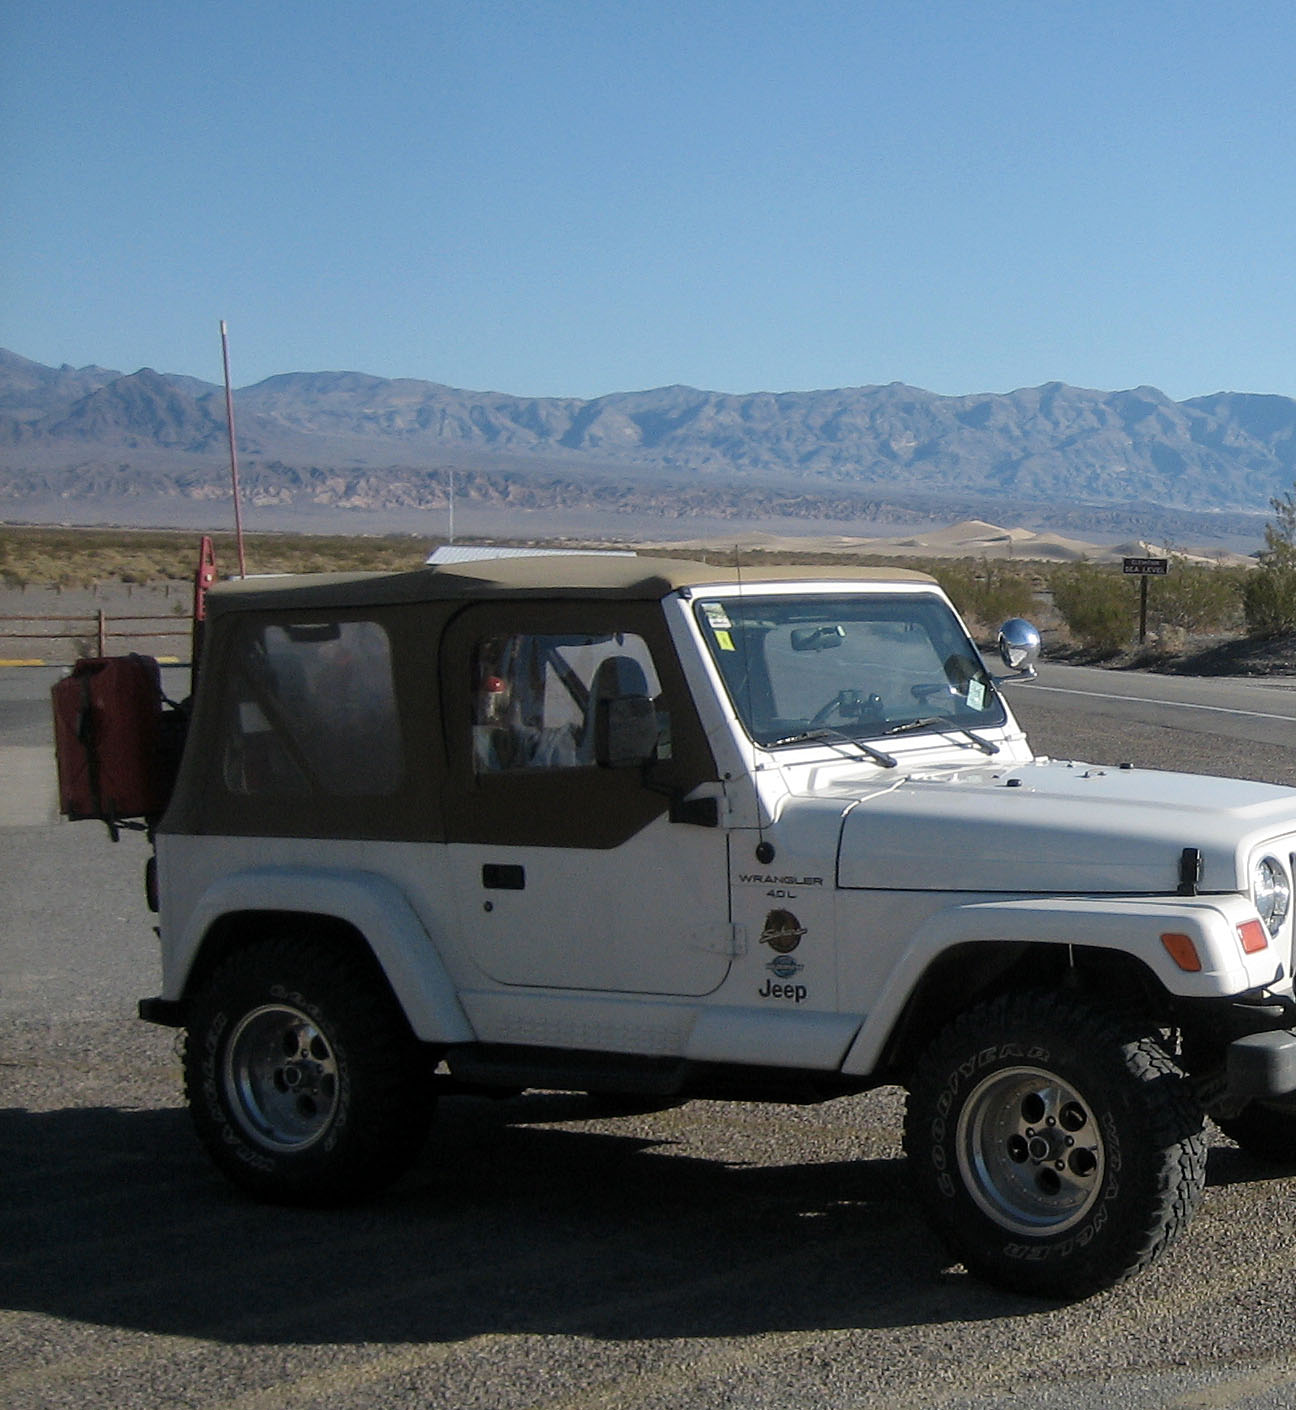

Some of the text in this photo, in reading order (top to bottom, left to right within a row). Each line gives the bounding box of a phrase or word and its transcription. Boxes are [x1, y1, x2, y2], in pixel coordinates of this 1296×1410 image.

[1142, 566, 1165, 574] LEVEL
[739, 874, 823, 886] WRANGLER
[759, 978, 807, 1002] Jeep
[931, 1043, 1050, 1198] GOODYEAR
